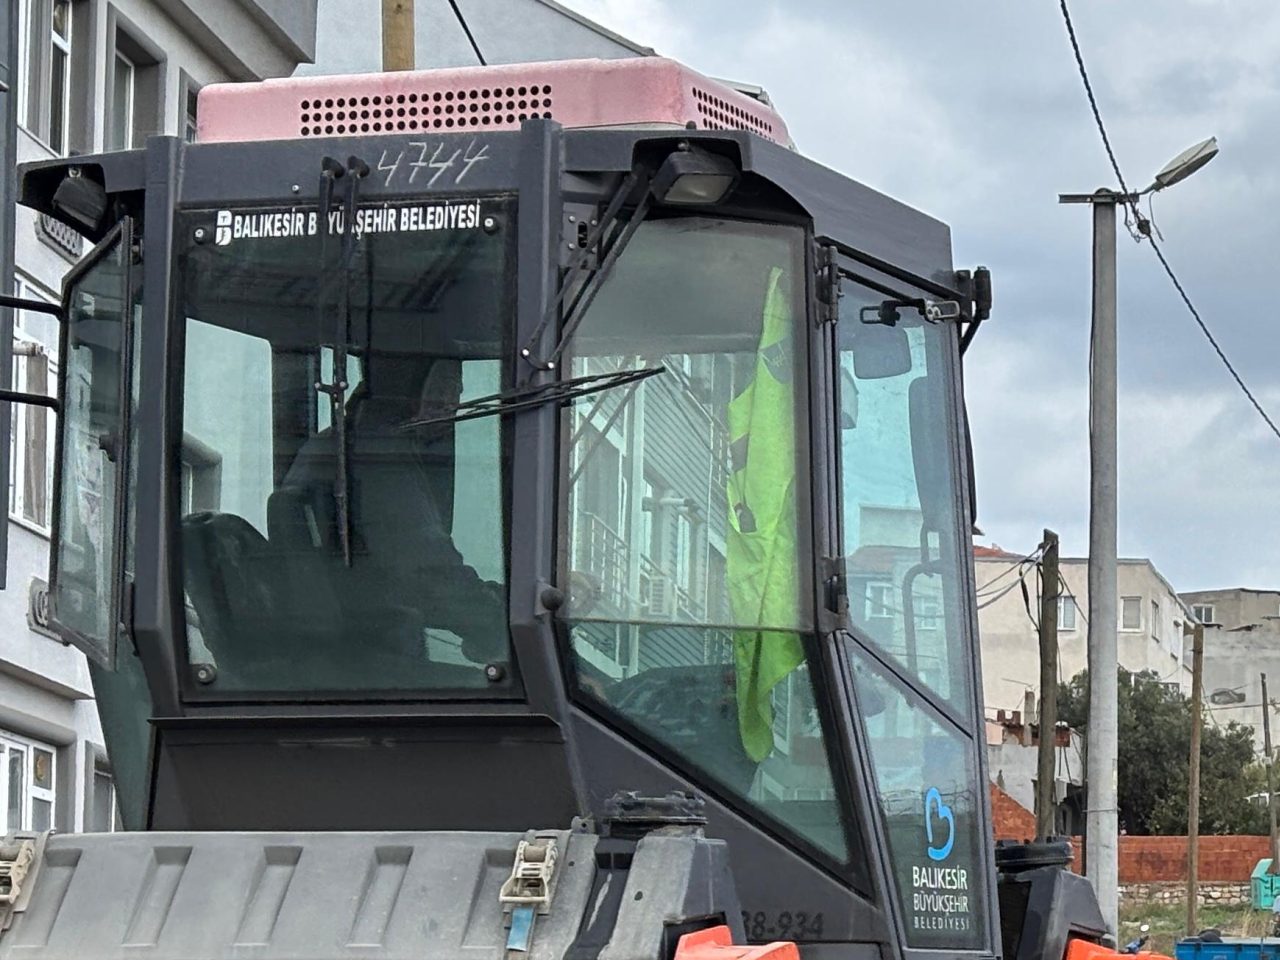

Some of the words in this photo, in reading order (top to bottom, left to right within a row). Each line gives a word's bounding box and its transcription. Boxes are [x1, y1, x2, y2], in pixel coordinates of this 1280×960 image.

[378, 137, 489, 188] 4744
[233, 207, 304, 239] BALIKESİR
[307, 203, 397, 240] BYÜŞEHİR
[399, 198, 481, 231] BELEDİYESİ
[912, 865, 968, 890] BALIKESİR
[913, 890, 969, 917] BÜYÜKŞEHİR
